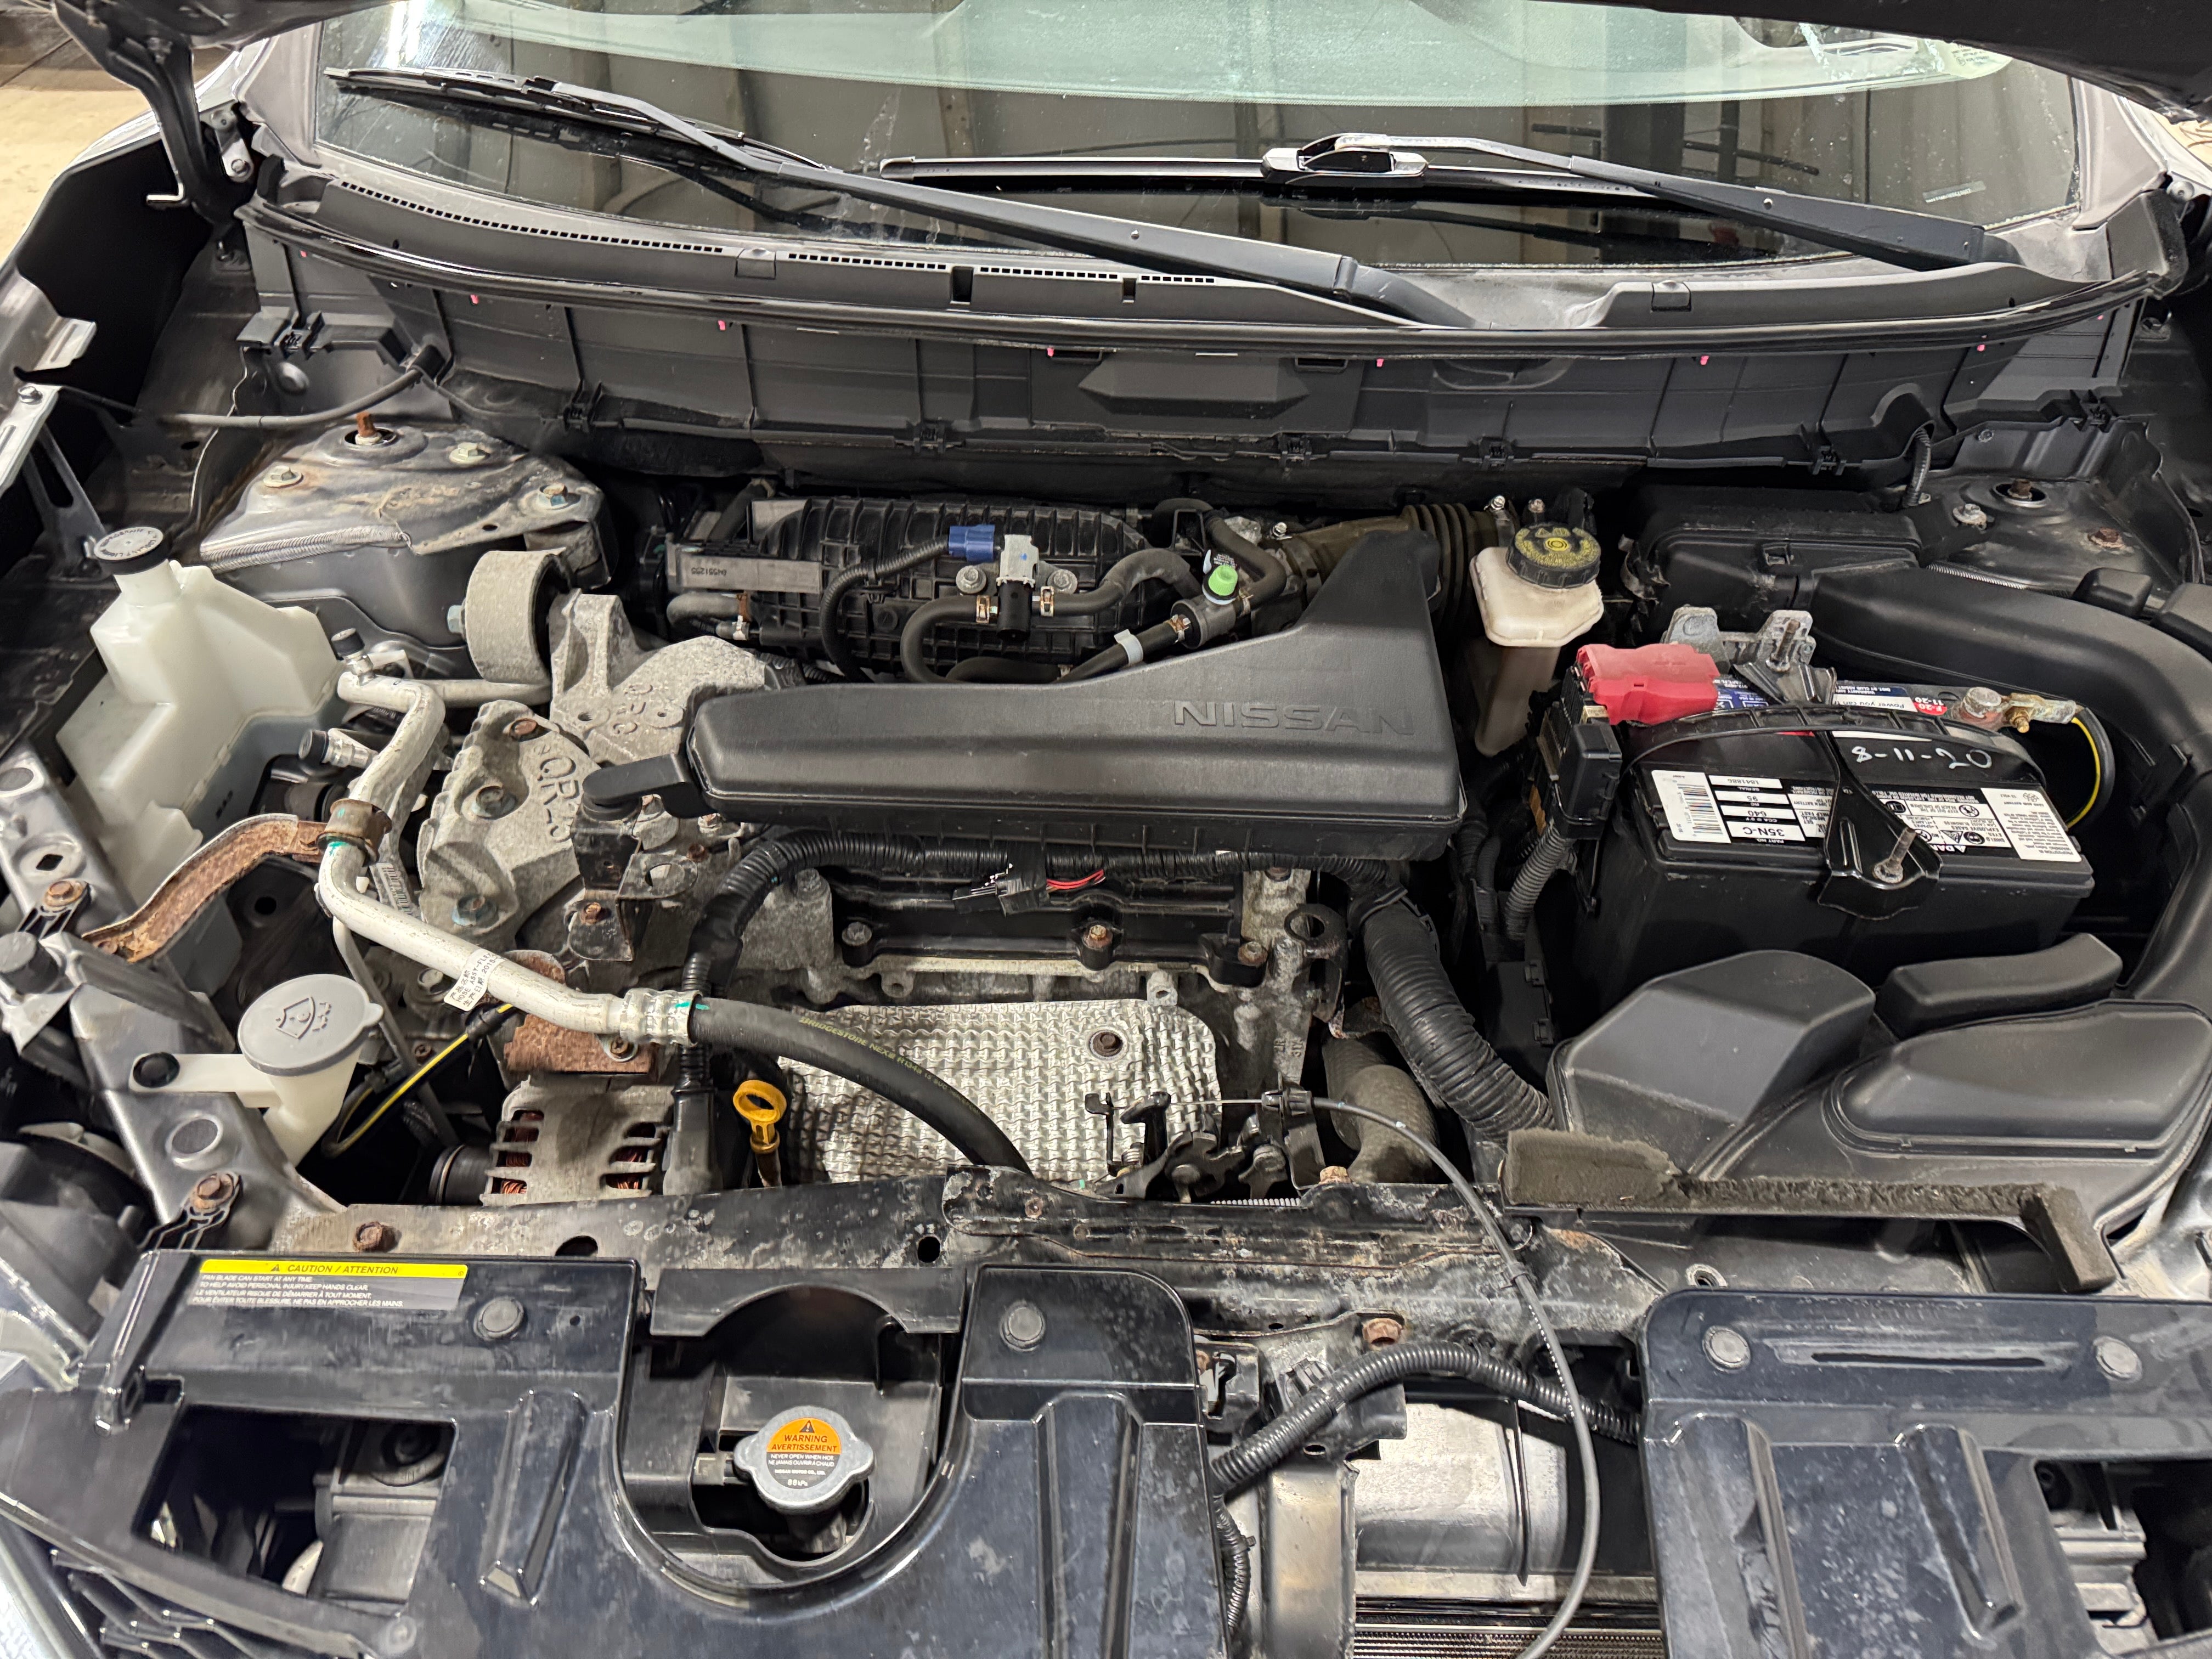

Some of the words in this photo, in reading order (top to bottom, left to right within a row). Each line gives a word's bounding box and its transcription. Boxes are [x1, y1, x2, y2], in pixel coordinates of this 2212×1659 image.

[1915, 697, 1944, 706] 11-20
[1173, 701, 1415, 735] NISSAN
[1852, 746, 1992, 769] 8-11-20
[1742, 826, 1785, 837] 35N-C
[455, 988, 471, 1002] HOSE
[798, 1017, 868, 1046] BRIDGESTONE
[343, 1266, 398, 1274] ATTENTION
[785, 1435, 828, 1443] WARNING
[771, 1444, 838, 1452] AVERTISSEMENT
